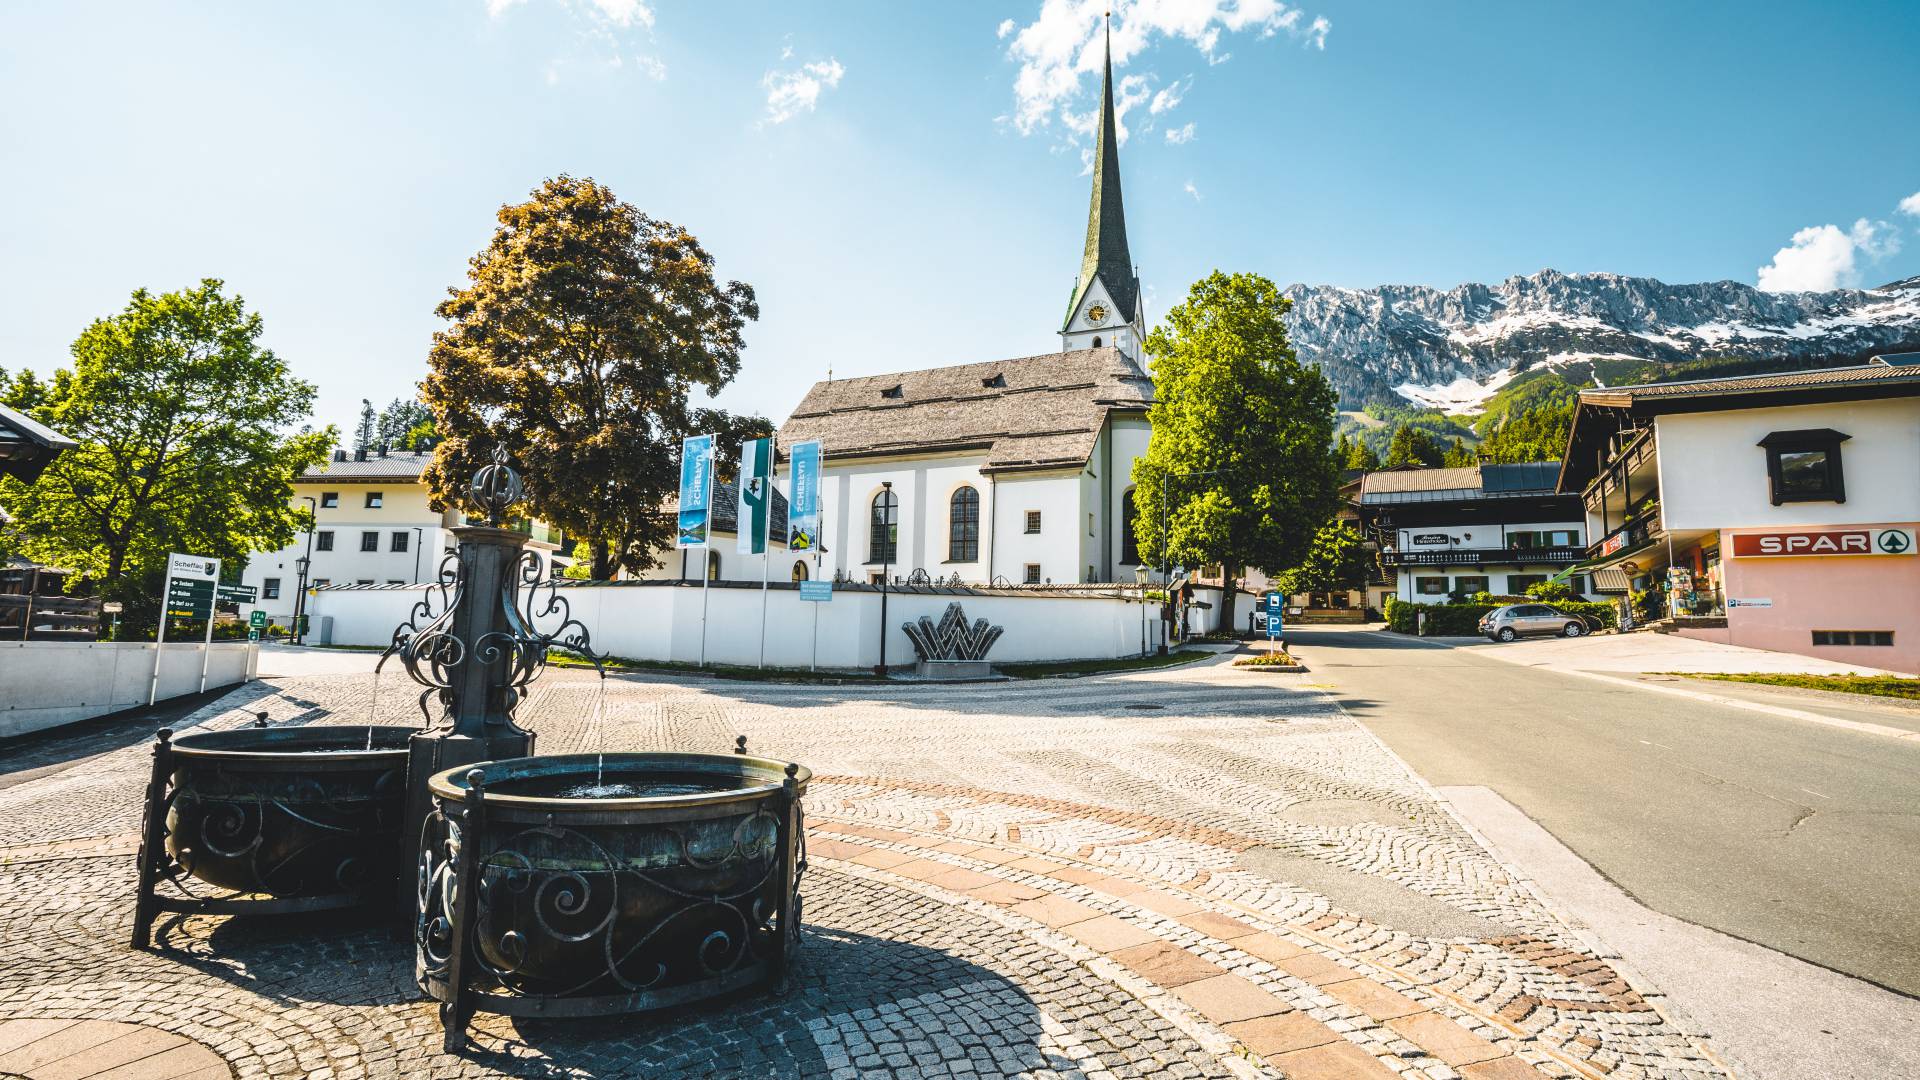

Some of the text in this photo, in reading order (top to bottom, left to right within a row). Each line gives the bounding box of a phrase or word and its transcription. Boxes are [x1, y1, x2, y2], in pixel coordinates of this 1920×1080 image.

[1760, 535, 1867, 553] SPAR
[175, 561, 203, 569] Scheffau
[1270, 618, 1279, 630] P
